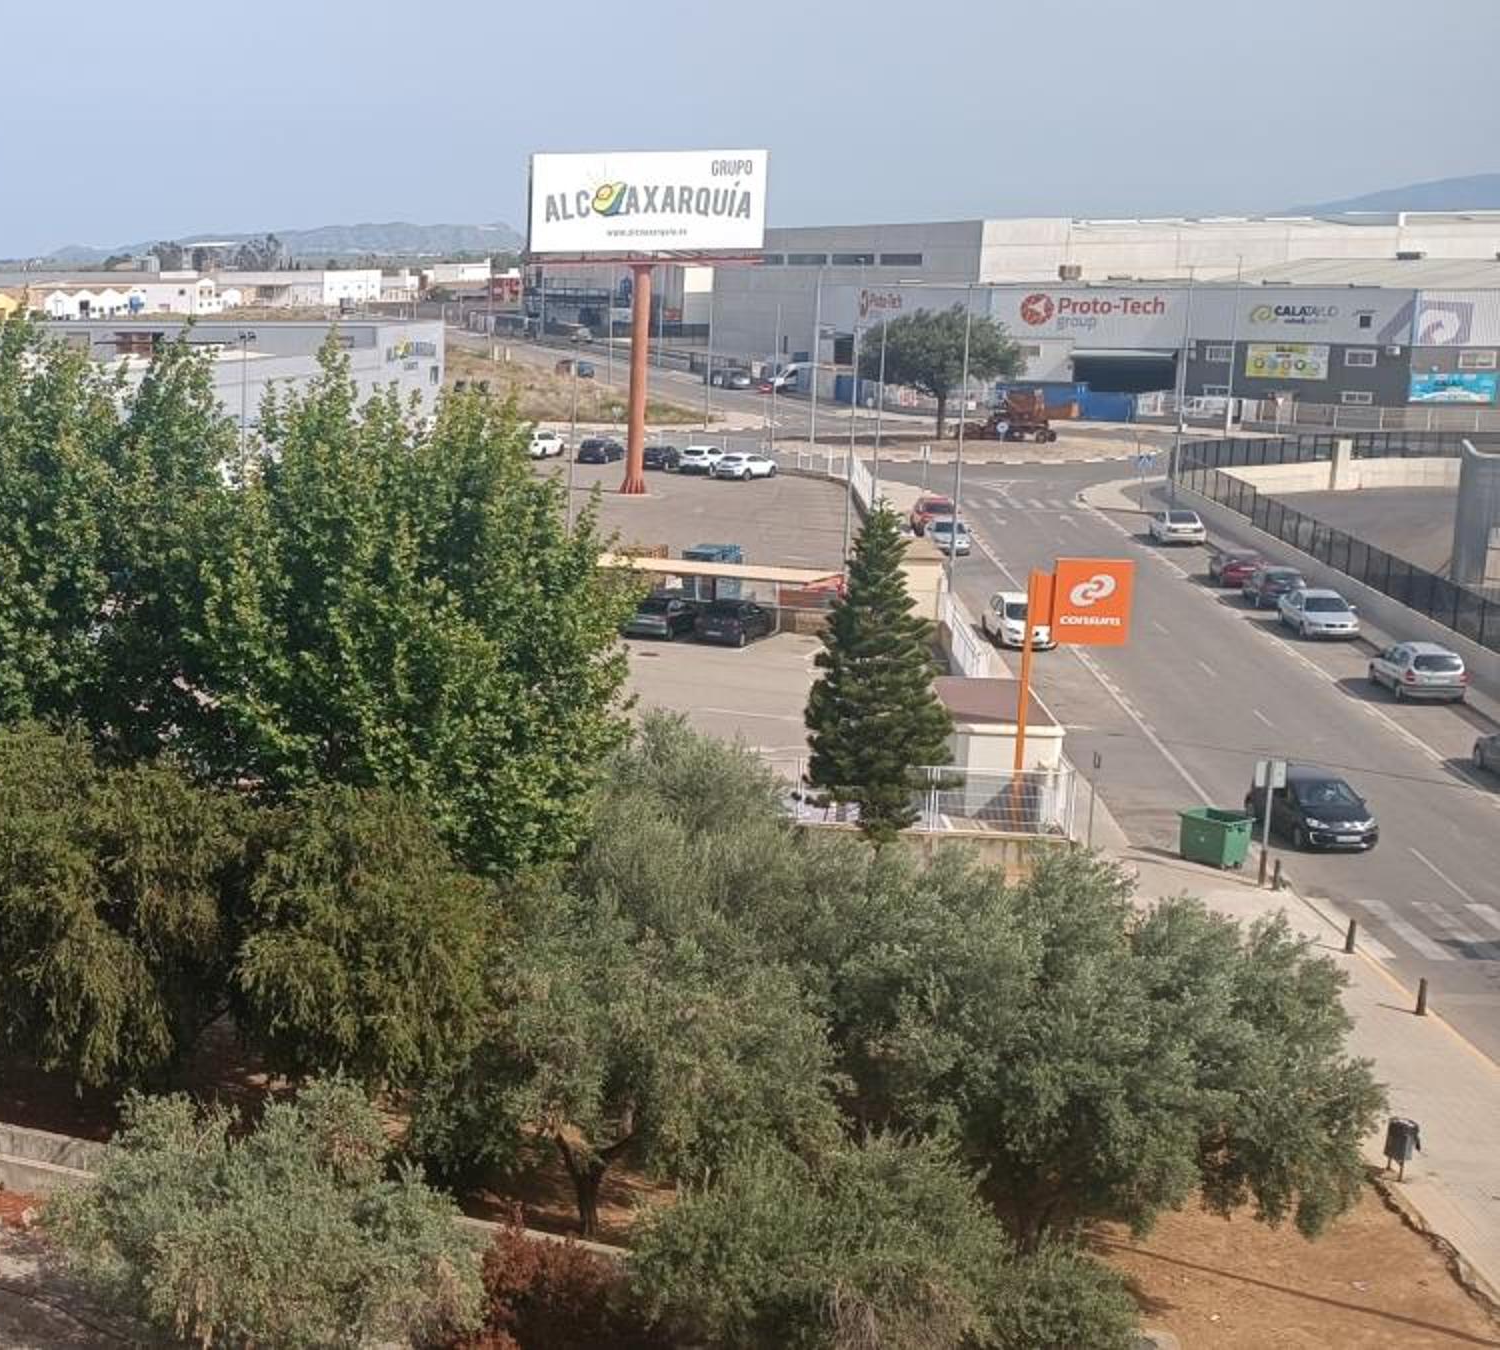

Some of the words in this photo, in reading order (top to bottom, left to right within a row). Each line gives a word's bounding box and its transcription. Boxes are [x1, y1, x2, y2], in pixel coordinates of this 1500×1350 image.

[711, 159, 753, 177] GRUPO
[1057, 296, 1166, 315] Proto-Tech
[1056, 316, 1097, 331] group
